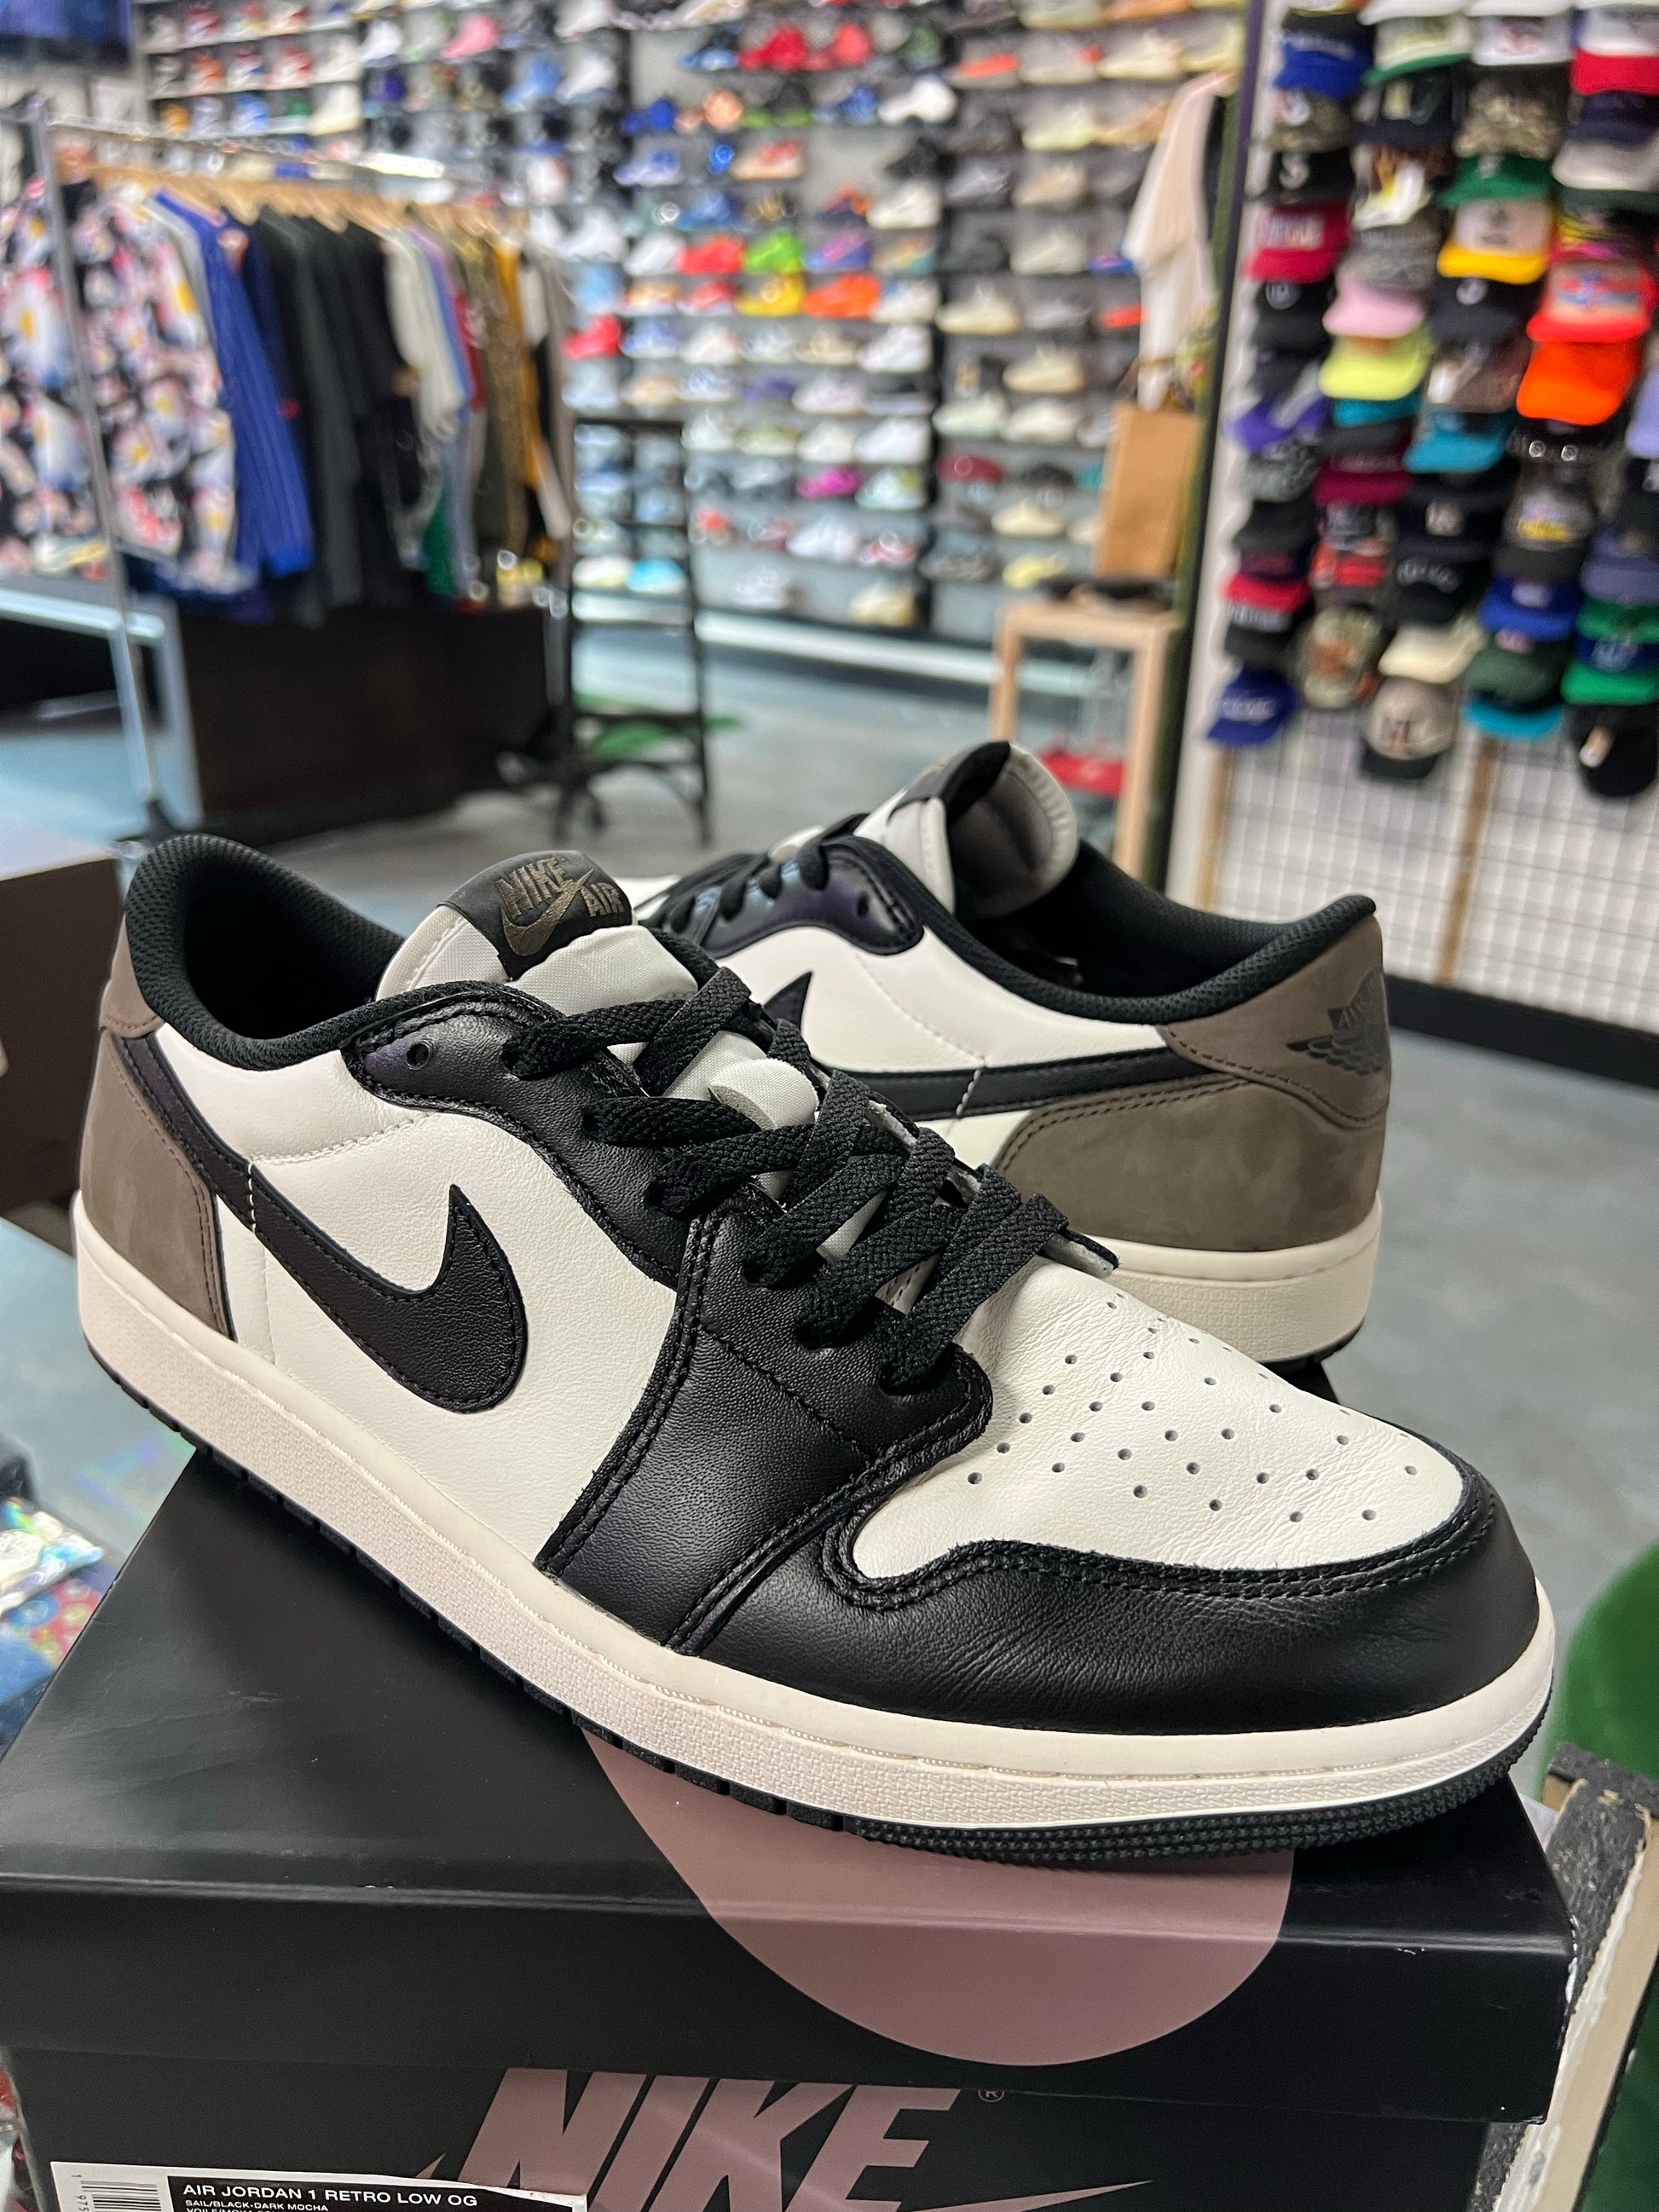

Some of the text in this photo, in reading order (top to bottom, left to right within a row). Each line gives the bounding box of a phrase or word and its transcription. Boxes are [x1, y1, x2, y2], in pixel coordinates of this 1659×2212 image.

[496, 857, 574, 920] NIKE
[580, 882, 625, 917] AIR
[457, 2068, 962, 2212] NIKE
[182, 2184, 477, 2207] AIR JORDAN 1 RETRO LOW OG
[185, 2199, 329, 2212] SAIL/BLACK-DARK MOCHA
